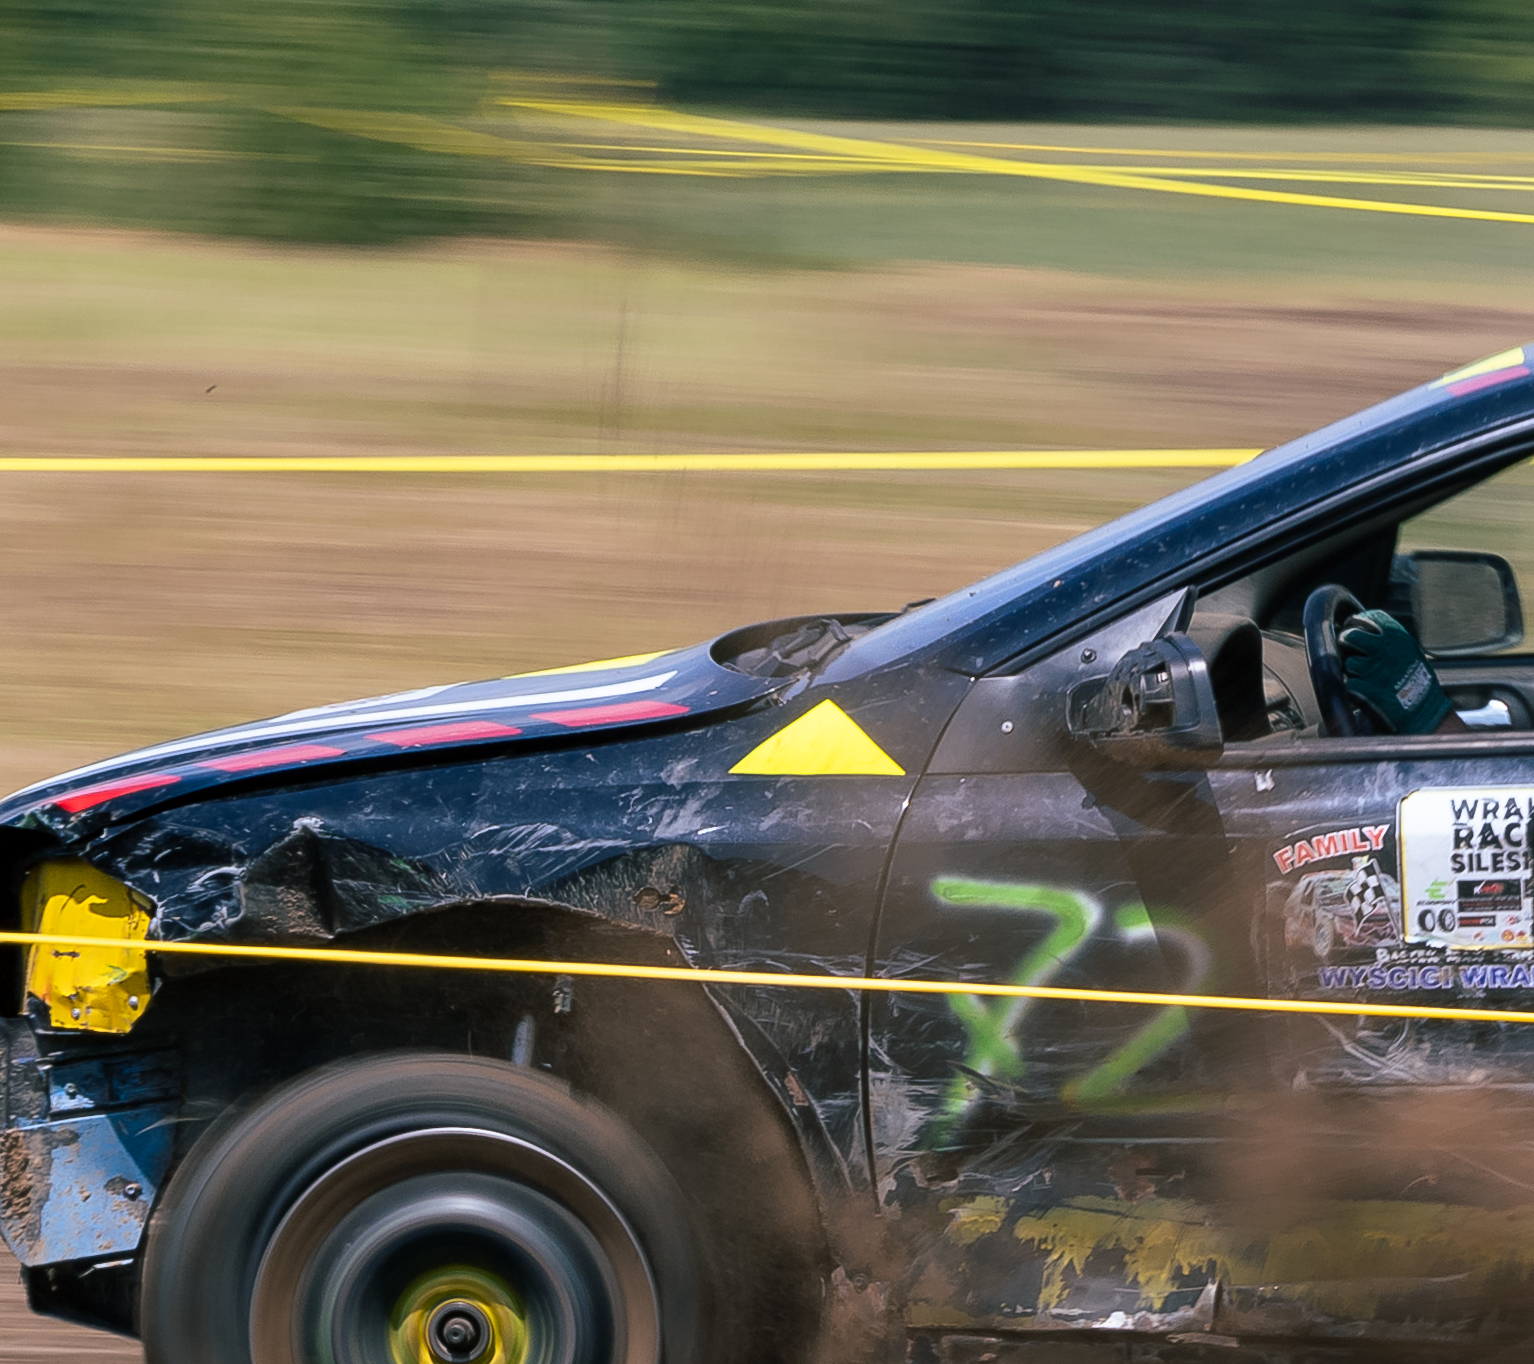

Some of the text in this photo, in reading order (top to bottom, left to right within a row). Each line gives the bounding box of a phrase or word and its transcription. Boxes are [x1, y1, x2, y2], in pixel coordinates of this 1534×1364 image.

[1272, 823, 1390, 875] FAMILY
[1452, 822, 1523, 850] RAC
[1450, 851, 1529, 874] SILESI
[1317, 959, 1452, 990] WYŚCIGI
